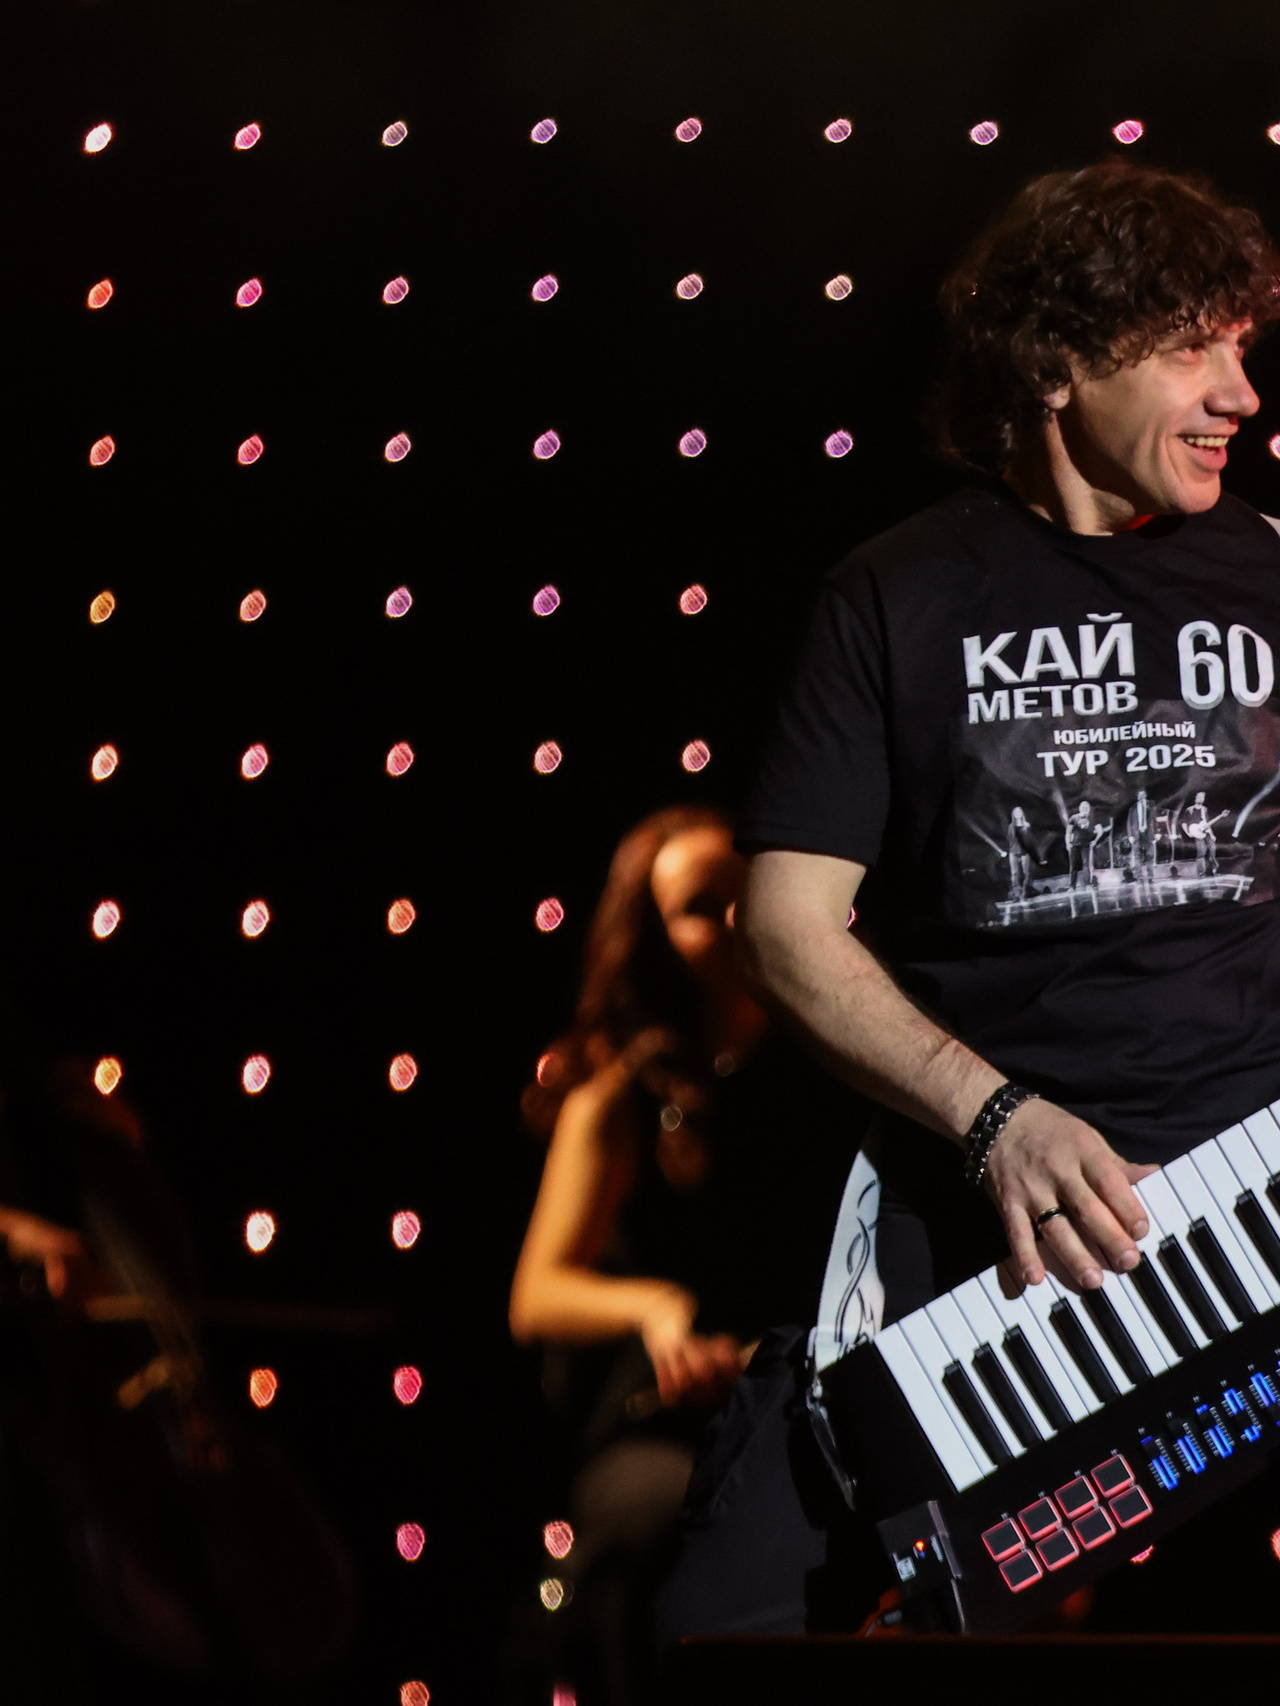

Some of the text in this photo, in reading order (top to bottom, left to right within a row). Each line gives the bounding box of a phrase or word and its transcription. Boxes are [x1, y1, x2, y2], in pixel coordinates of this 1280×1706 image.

[962, 612, 1275, 710] КАЙ 60
[967, 681, 1139, 724] МЕТОВ
[1053, 720, 1197, 746] ЮБИЛЕЙНЫЙ
[1036, 744, 1216, 778] ТУР 2025
